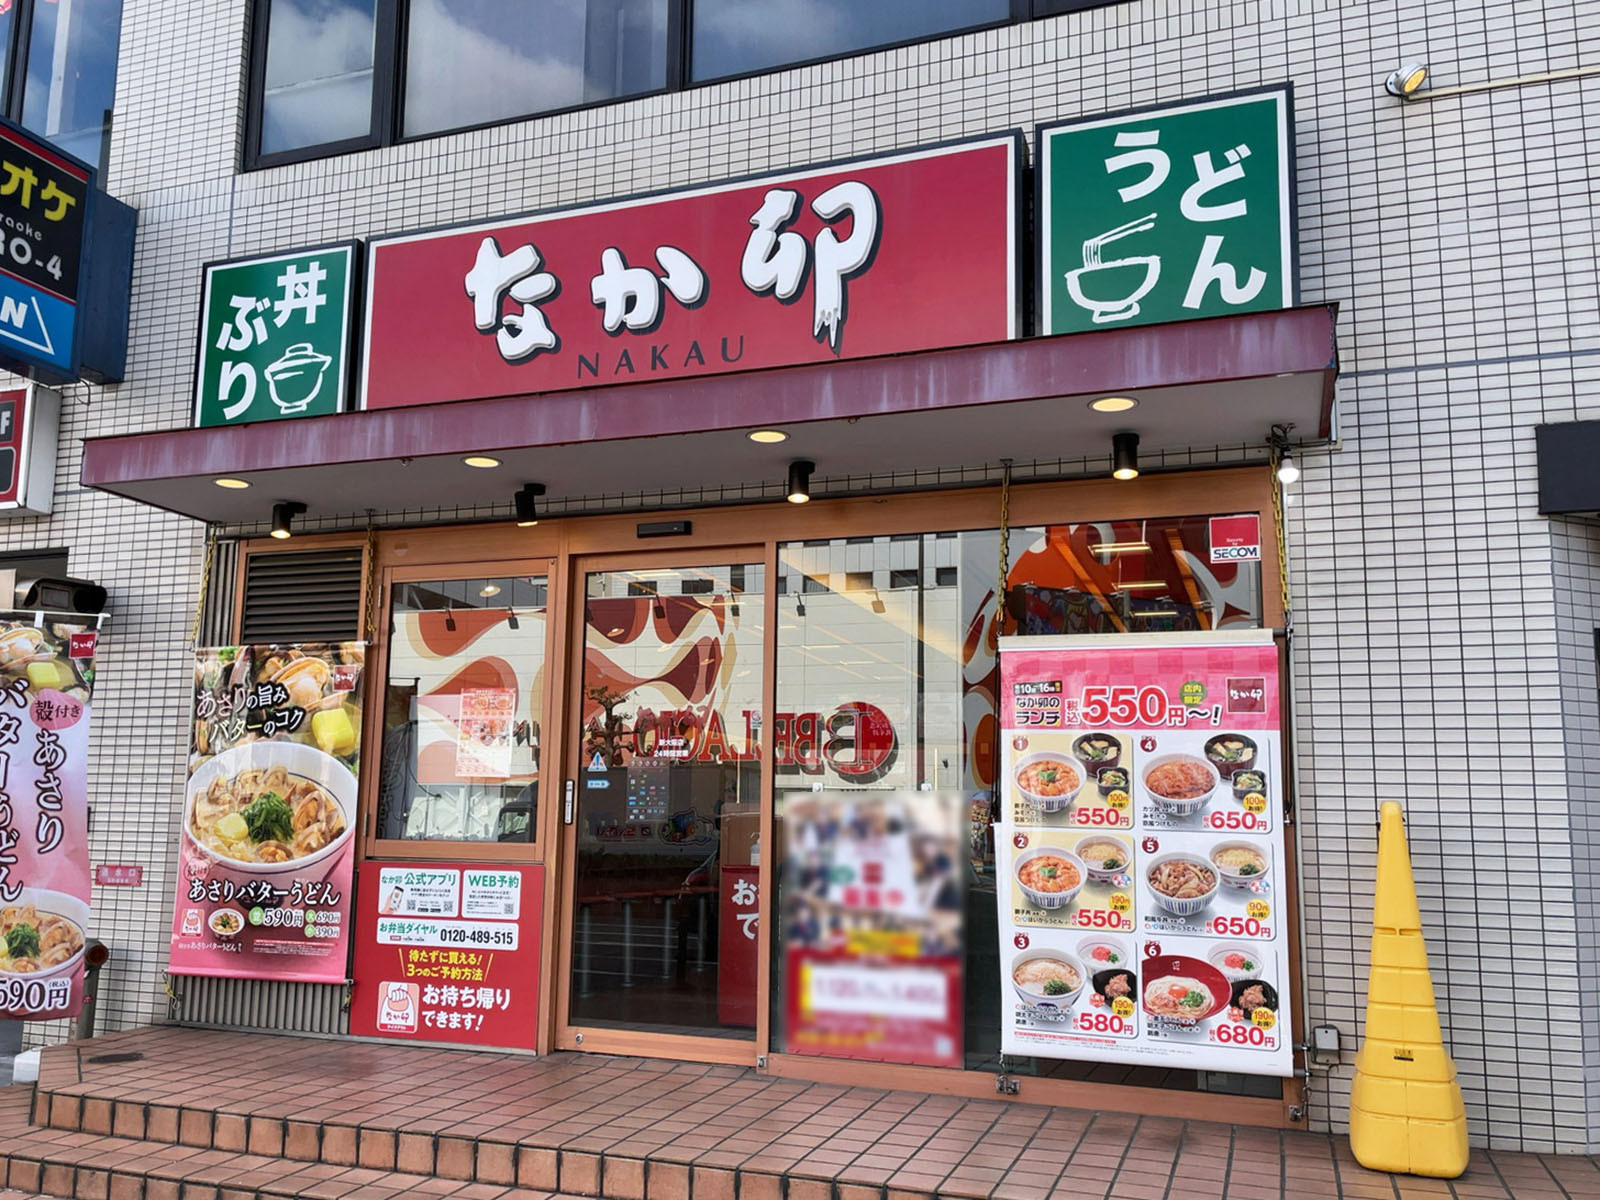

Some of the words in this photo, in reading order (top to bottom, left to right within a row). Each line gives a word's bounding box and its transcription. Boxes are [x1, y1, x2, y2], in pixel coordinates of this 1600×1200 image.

[465, 181, 878, 360] なか卯
[1, 296, 28, 329] N
[578, 335, 744, 378] NAKAU
[1214, 547, 1257, 559] SECOM
[196, 684, 287, 718] あさりの旨み
[1016, 696, 1060, 708] なか卯の
[1230, 688, 1263, 701] なか卯
[34, 699, 81, 723] 殻付き
[1016, 711, 1060, 725] ランチ
[208, 708, 305, 743] バターのコク
[1018, 738, 1024, 749] 1
[1145, 739, 1153, 750] 4
[33, 728, 66, 854] あさり
[1077, 807, 1129, 826] 550円
[1210, 811, 1267, 830] 650円
[1017, 837, 1025, 848] 2
[1147, 841, 1155, 852] 5
[381, 875, 402, 885] なか卯
[404, 872, 457, 886] 公式アプリ
[468, 875, 519, 889] WEB予約
[189, 877, 340, 906] あさりバターうどん
[732, 879, 759, 906] お
[264, 909, 303, 926] 590円
[1078, 909, 1131, 929] 550円
[1213, 916, 1271, 938] 650円
[379, 922, 438, 935] お弁当ダイヤル
[440, 928, 513, 945] 0120-489-515
[1018, 936, 1025, 947] 3
[408, 948, 482, 966] 待たずに買える!
[1149, 944, 1156, 956] 6
[406, 964, 483, 982] 3つのご予約方法
[422, 983, 510, 1011] お持ち帰り
[421, 1009, 484, 1032] できます!
[1079, 1012, 1134, 1035] 580円
[1216, 1024, 1275, 1048] 680円
